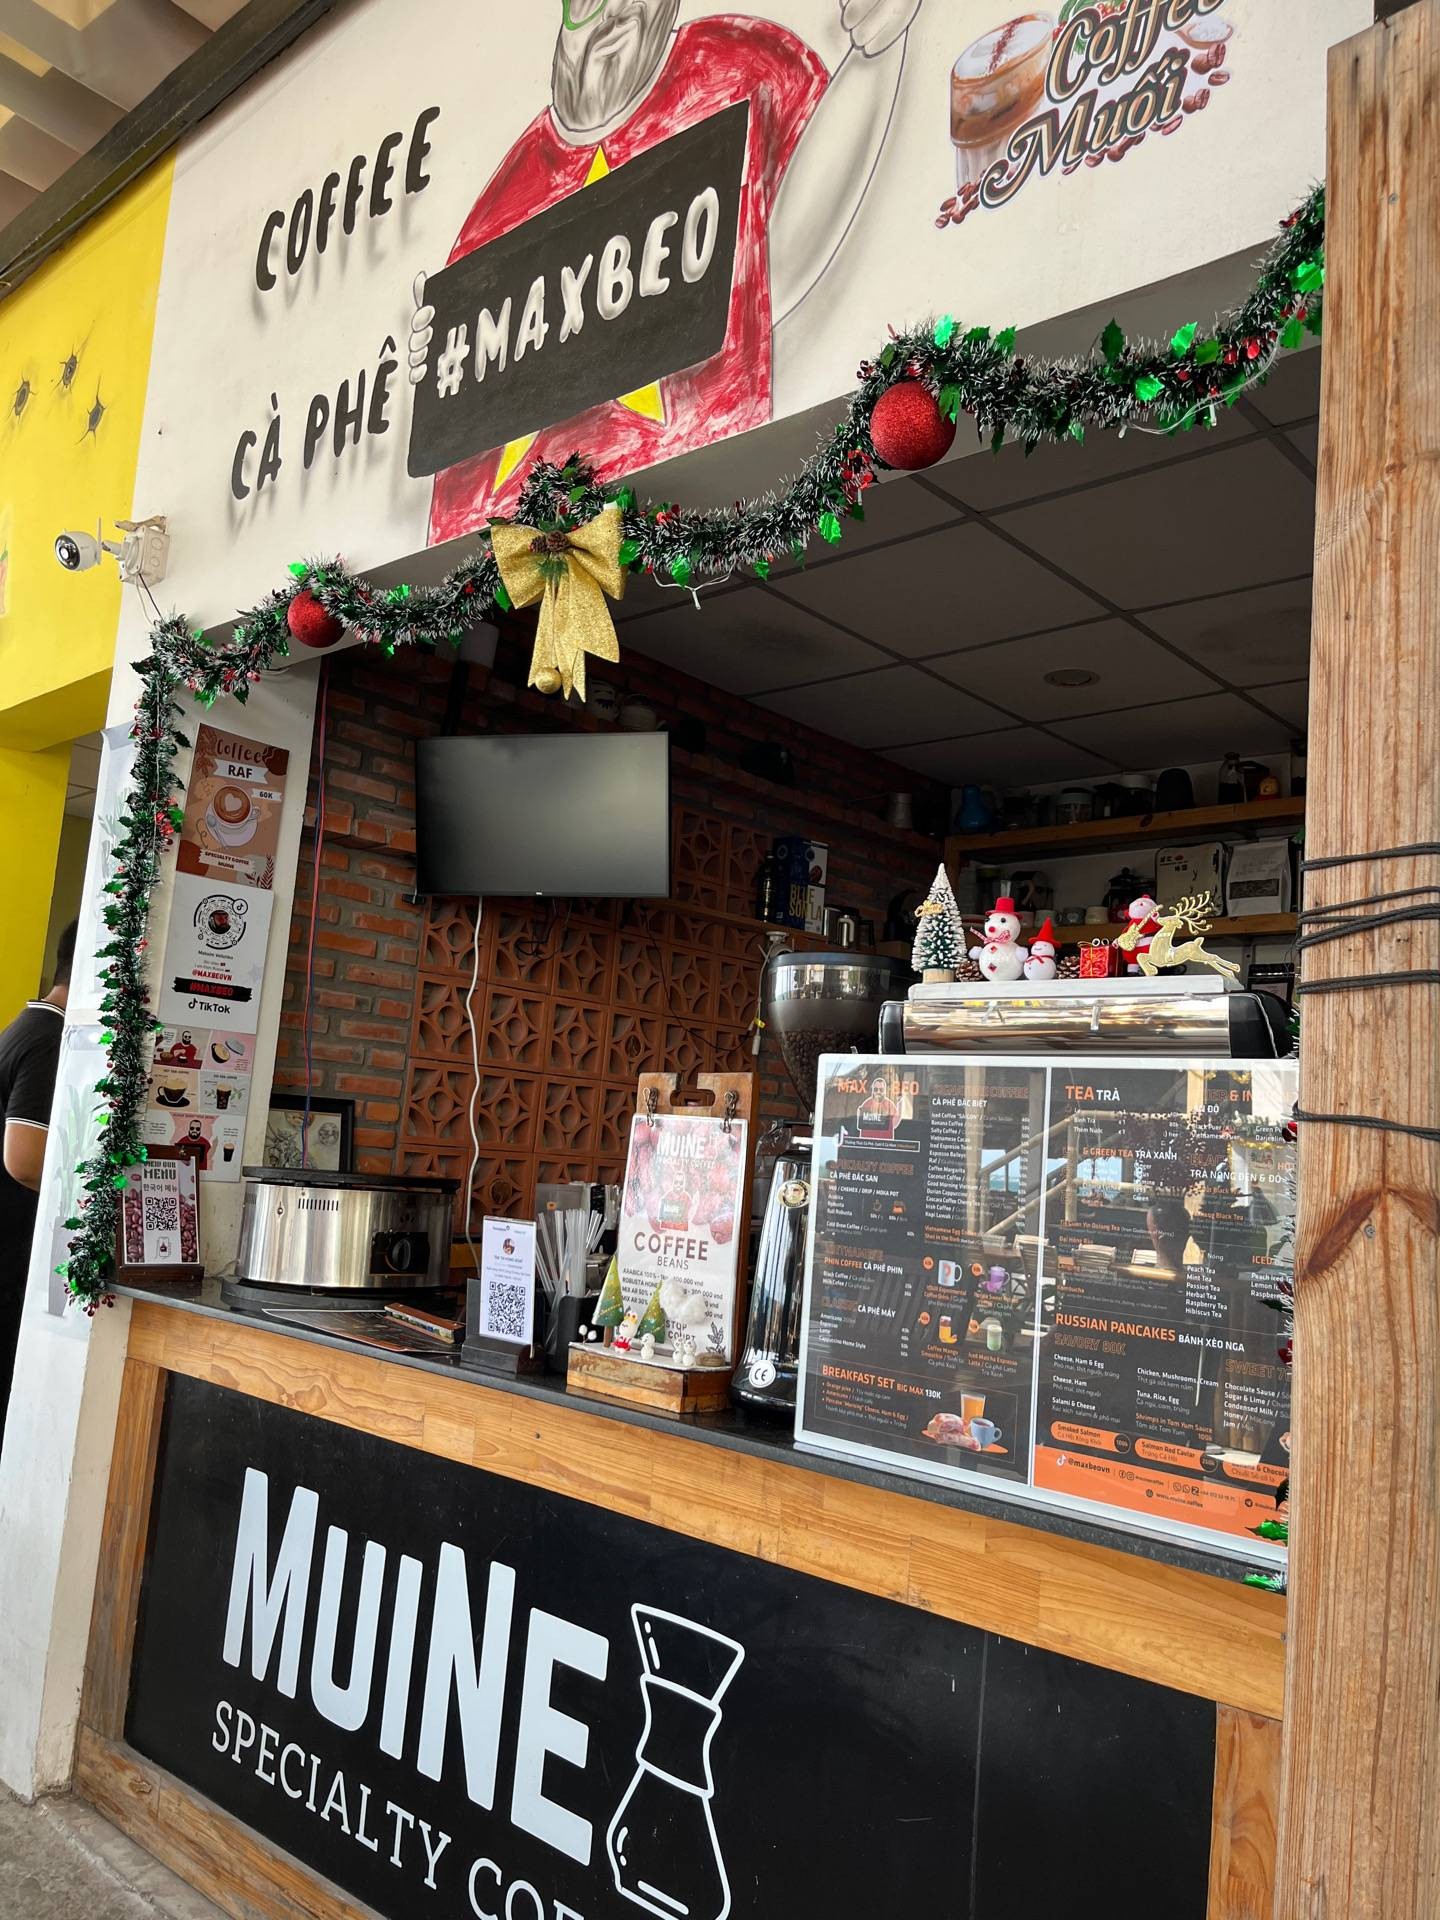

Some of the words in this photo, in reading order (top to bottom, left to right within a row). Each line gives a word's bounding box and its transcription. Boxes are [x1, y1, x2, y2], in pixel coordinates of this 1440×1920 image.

[256, 107, 441, 291] COFFEE
[436, 187, 720, 398] #MAXBEO
[231, 392, 282, 500] CÀ
[303, 336, 399, 470] PHÊ
[216, 738, 263, 764] Coffee
[228, 764, 253, 779] RAF
[259, 790, 273, 799] 60K
[191, 968, 233, 982] @MAXBEOVN
[189, 982, 234, 996] #MAXBEO
[199, 1001, 230, 1014] TikTok
[837, 1080, 868, 1094] MAX
[889, 1079, 920, 1096] BEO
[1064, 1085, 1095, 1101] TEA
[1096, 1087, 1121, 1101] TRÀ
[1255, 1125, 1274, 1133] Green
[657, 1131, 706, 1159] MUINE
[1090, 1147, 1117, 1158] GREEN
[1118, 1148, 1134, 1159] TEA
[1153, 1150, 1178, 1161] XANH
[143, 1169, 177, 1180] MENU
[1190, 1167, 1209, 1179] TRÀ
[634, 1231, 709, 1261] COFFEE
[657, 1255, 689, 1270] BEANS
[824, 1257, 840, 1266] PHIN
[840, 1259, 863, 1268] COFFEE
[863, 1261, 872, 1271] CÀ
[886, 1265, 904, 1275] PHIN
[1252, 1255, 1272, 1266] ICED
[1186, 1265, 1205, 1274] Peach
[1205, 1266, 1216, 1275] Tea
[1251, 1272, 1270, 1281] Peach
[644, 1281, 660, 1289] HONE
[1186, 1273, 1201, 1282] Mint
[1201, 1275, 1212, 1283] Tea
[1250, 1281, 1270, 1290] Lemon
[1186, 1282, 1209, 1292] Passion
[1210, 1284, 1221, 1292] Tea
[1185, 1290, 1206, 1299] Herbal
[1206, 1292, 1217, 1301] Tea
[857, 1303, 867, 1313] CÀ
[880, 1307, 897, 1318] MÁY
[1185, 1299, 1216, 1310] Raspberry
[1217, 1302, 1228, 1311] Tea
[1185, 1307, 1211, 1317] Hibiscus
[1211, 1310, 1222, 1319] Tea
[1056, 1312, 1108, 1332] RUSSIAN
[1110, 1321, 1176, 1342] PANCAKES
[1178, 1333, 1204, 1347] BÁNH
[1225, 1341, 1245, 1353] NGA
[1054, 1332, 1101, 1352] SAVORY
[1053, 1353, 1074, 1364] Cheese,
[1075, 1357, 1088, 1366] Ham
[1094, 1359, 1105, 1370] Egg
[1225, 1357, 1274, 1378] SWEET
[822, 1364, 876, 1386] BREAKFAST
[877, 1376, 896, 1390] SET
[896, 1383, 908, 1393] BIG
[908, 1384, 925, 1396] MAX
[925, 1388, 942, 1399] 130K
[1052, 1375, 1074, 1386] Cheese,
[1074, 1378, 1088, 1387] Ham
[1137, 1367, 1161, 1379] Chicken,
[1199, 1377, 1219, 1388] Cream
[1136, 1389, 1152, 1400] Tuna,
[1152, 1392, 1168, 1403] Rice,
[1168, 1395, 1180, 1406] Egg
[1224, 1382, 1256, 1394] Chocolate
[1256, 1386, 1276, 1398] Sause
[1051, 1396, 1071, 1406] Salami
[1076, 1400, 1097, 1411] Cheese
[1224, 1391, 1243, 1404] Sugar
[1249, 1395, 1266, 1406] Lime
[1223, 1401, 1258, 1414] Condensed
[1259, 1406, 1274, 1417] Milk
[1223, 1410, 1244, 1422] Honey
[1057, 1423, 1080, 1434] Smoked
[1080, 1427, 1101, 1438] Salmon
[1135, 1412, 1160, 1425] Shrimps
[1167, 1418, 1180, 1428] Tom
[1180, 1420, 1194, 1430] Yum
[1194, 1423, 1214, 1434] Sauce
[1223, 1419, 1236, 1429] Jam
[1141, 1441, 1164, 1451] Salmon
[1163, 1446, 1176, 1455] Red
[1176, 1448, 1196, 1458] Caviar
[1067, 1456, 1111, 1474] @maxbeovn
[223, 1467, 609, 1866] MUINE
[212, 1701, 451, 1890] SPECIALTY
